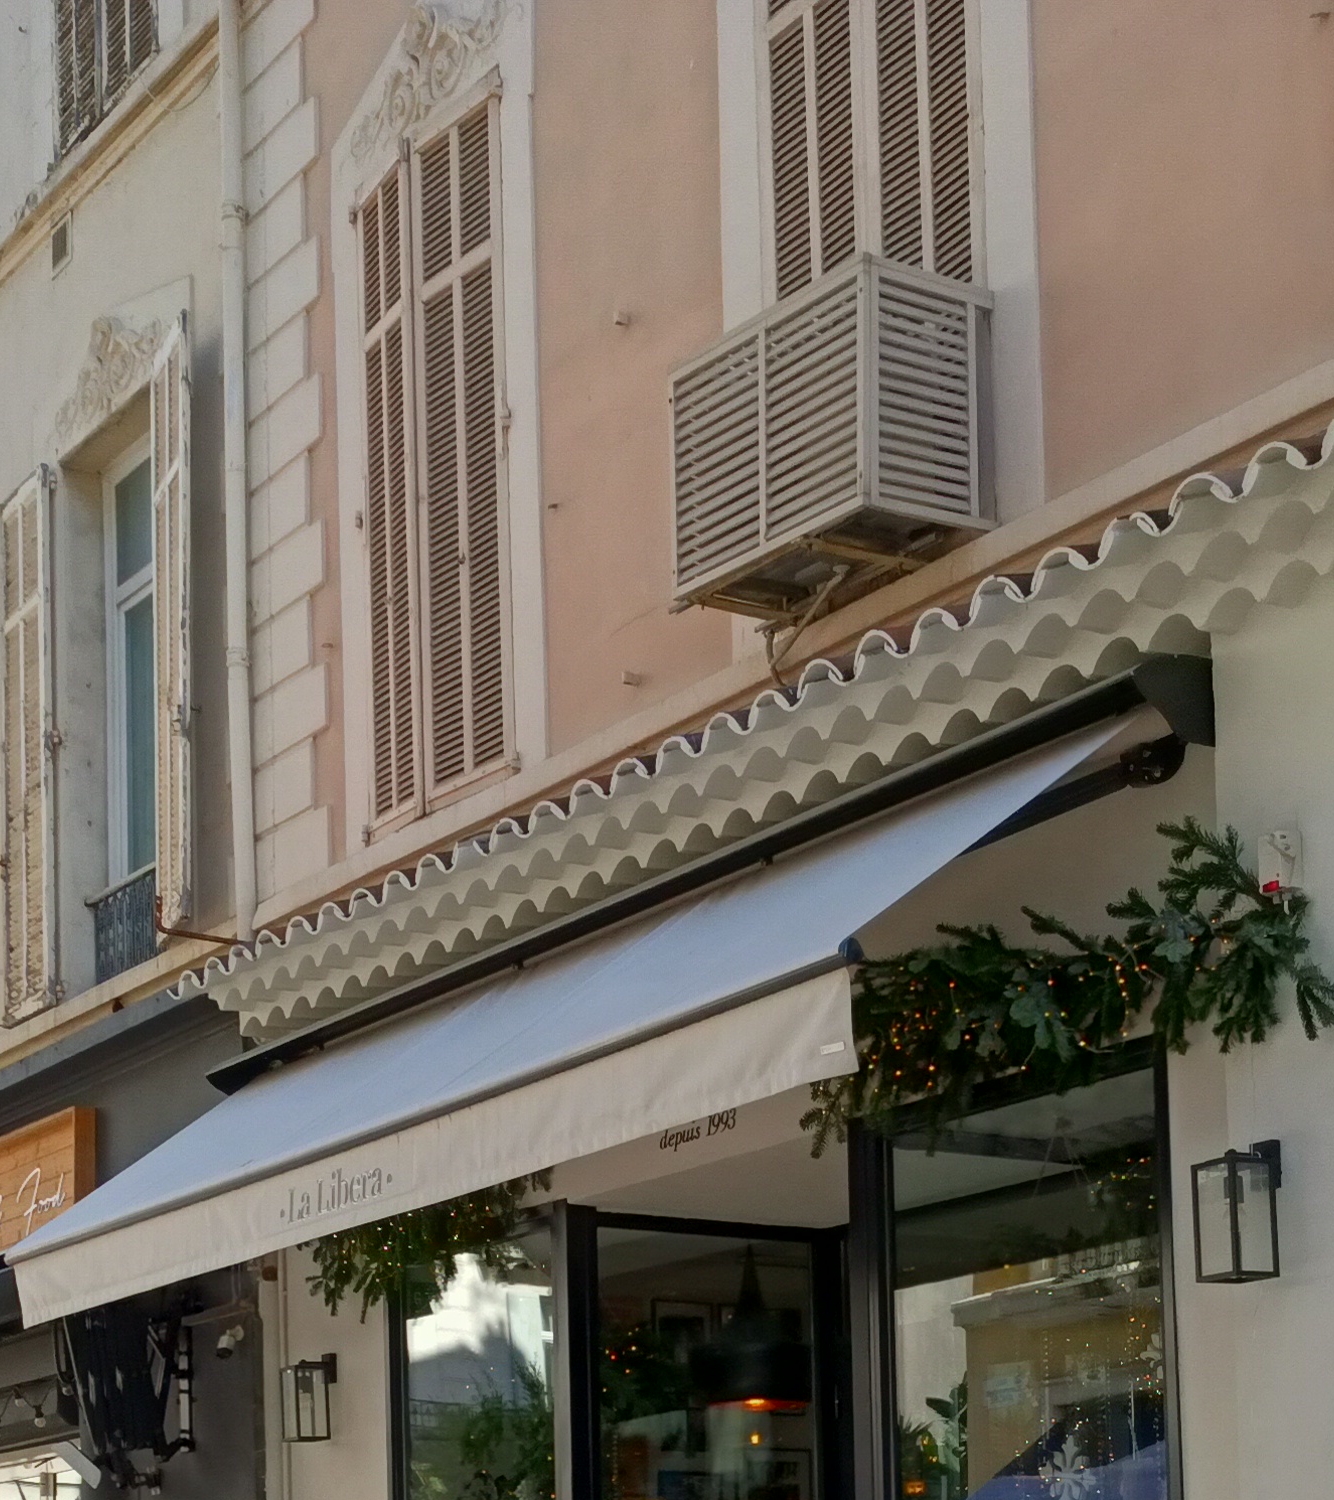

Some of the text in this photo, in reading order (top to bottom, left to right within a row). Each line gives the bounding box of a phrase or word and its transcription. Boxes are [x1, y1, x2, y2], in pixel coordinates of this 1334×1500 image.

[659, 1108, 737, 1152] depuis 1993
[17, 1167, 65, 1237] Food
[316, 1167, 383, 1216] Libera
